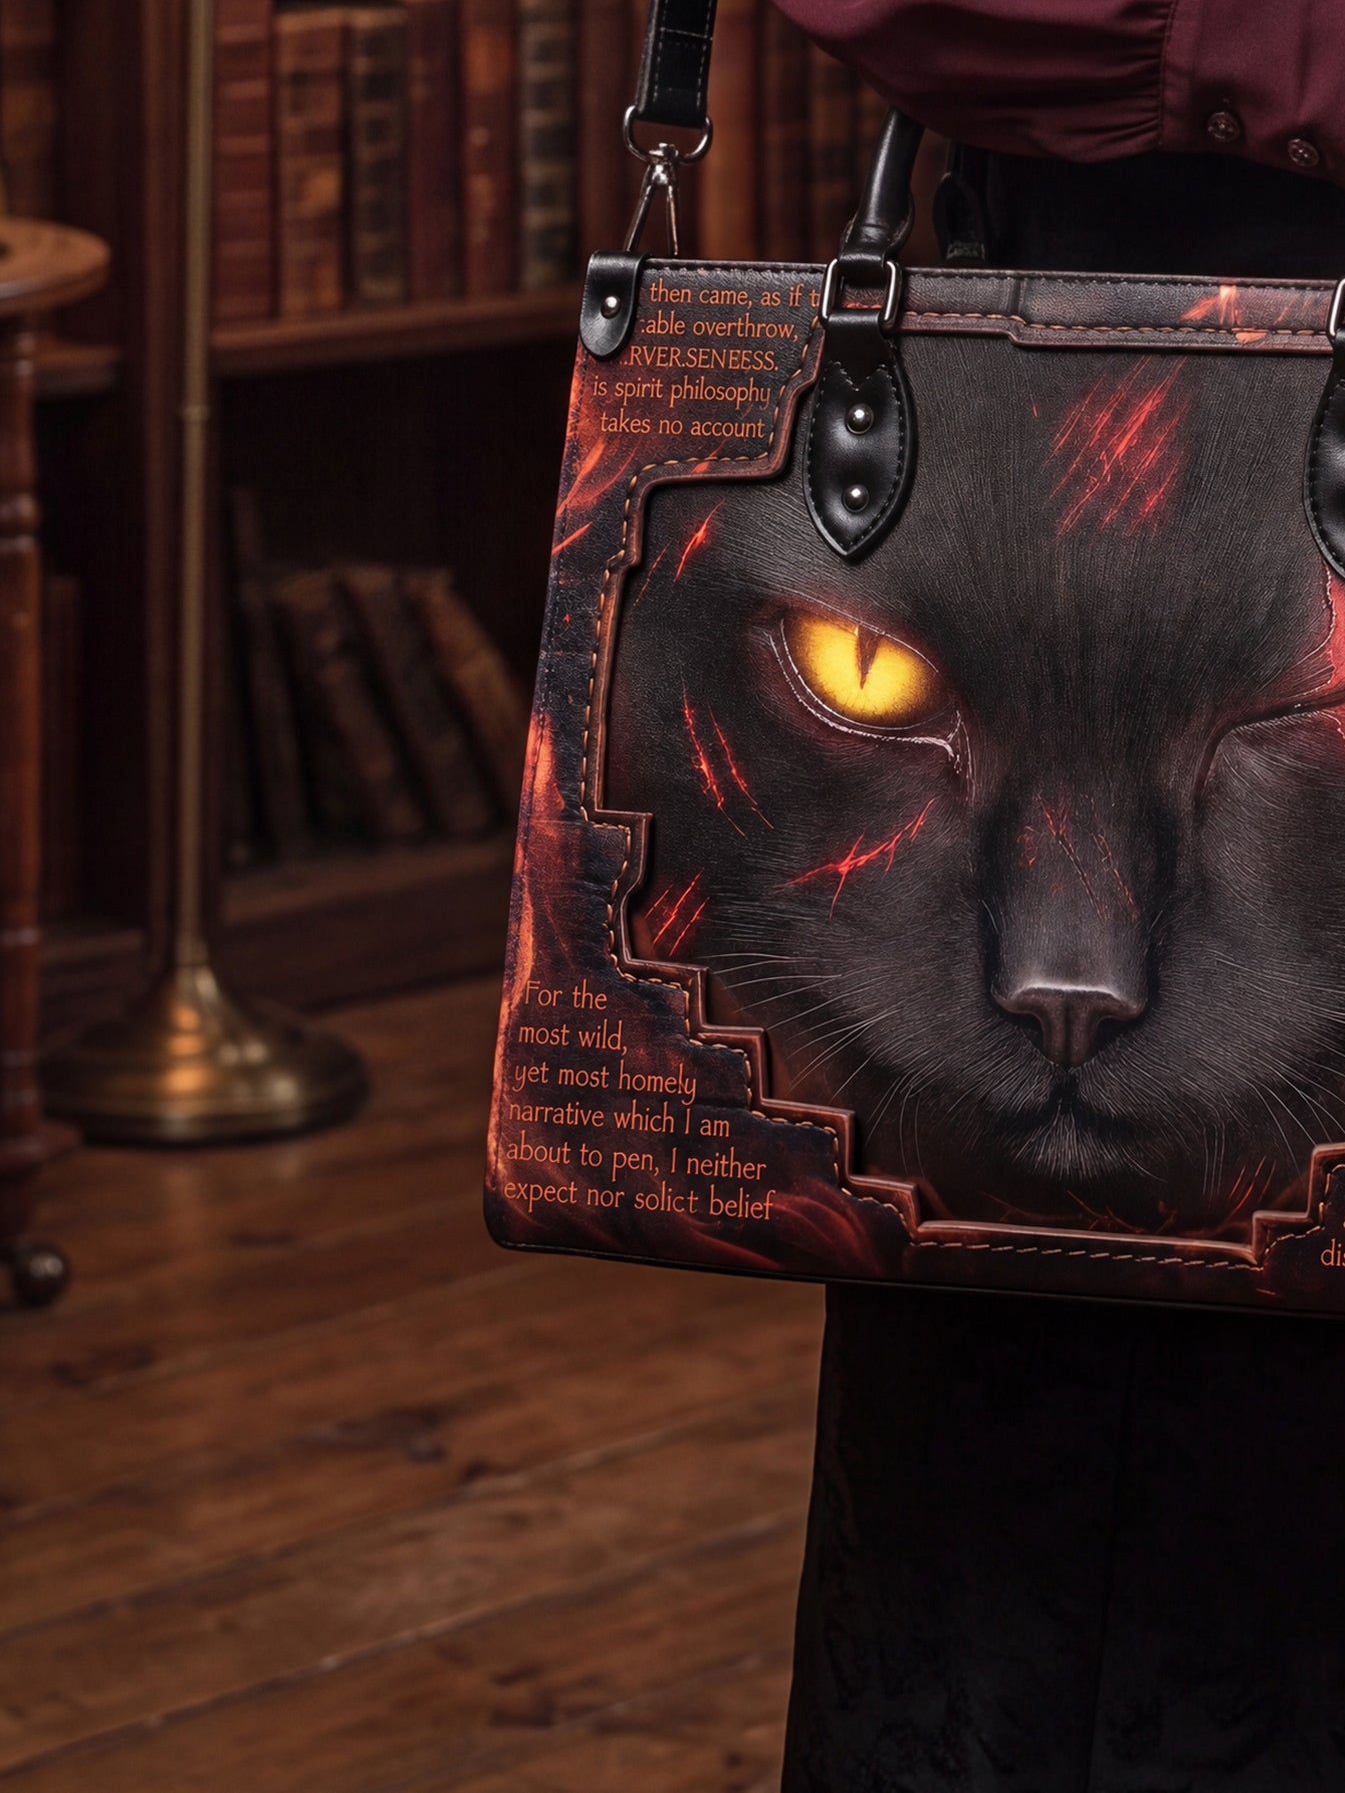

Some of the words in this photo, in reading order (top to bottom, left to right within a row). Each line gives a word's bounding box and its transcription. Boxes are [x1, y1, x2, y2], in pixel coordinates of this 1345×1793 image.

[650, 279, 692, 303] then
[699, 288, 752, 308] came,
[760, 291, 781, 306] as
[789, 283, 805, 306] if
[693, 314, 799, 341] overthrow,
[593, 375, 607, 396] is
[614, 377, 663, 406] spirit
[669, 375, 771, 411] philosophy
[600, 408, 651, 433] takes
[659, 419, 683, 435] no
[690, 418, 765, 439] account
[524, 981, 562, 1007] For
[572, 979, 607, 1010] the
[518, 1025, 570, 1046] most
[578, 1019, 628, 1054] wild,
[512, 1062, 549, 1092] yet
[558, 1065, 609, 1088] most
[618, 1060, 697, 1105] homely
[508, 1101, 604, 1127] narrative
[613, 1099, 675, 1133] which
[684, 1108, 691, 1134] I
[700, 1118, 730, 1137] am
[506, 1131, 571, 1164] about
[579, 1144, 603, 1167] to
[612, 1150, 660, 1182] pen,
[671, 1148, 677, 1173] I
[686, 1147, 767, 1180] neither
[503, 1181, 577, 1213] expect
[586, 1187, 625, 1207] nor
[634, 1181, 699, 1214] solict
[709, 1184, 776, 1220] belief
